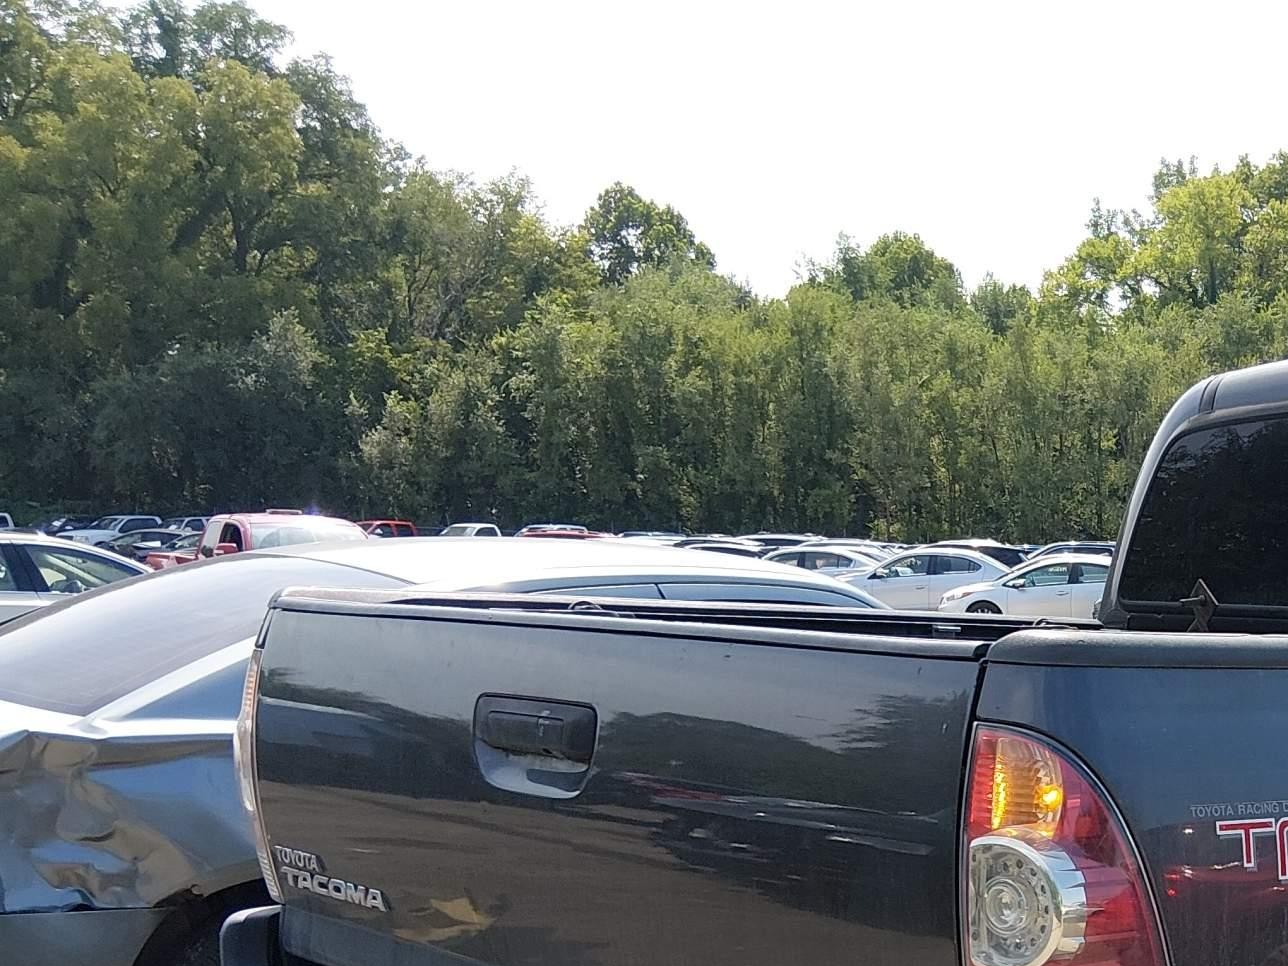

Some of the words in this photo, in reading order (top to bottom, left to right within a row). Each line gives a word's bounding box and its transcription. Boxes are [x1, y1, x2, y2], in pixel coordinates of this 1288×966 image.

[1190, 803, 1234, 818] TOYOTA
[1237, 800, 1280, 816] RACING
[273, 845, 322, 873] TOYOTA
[280, 866, 387, 912] TACOMA
